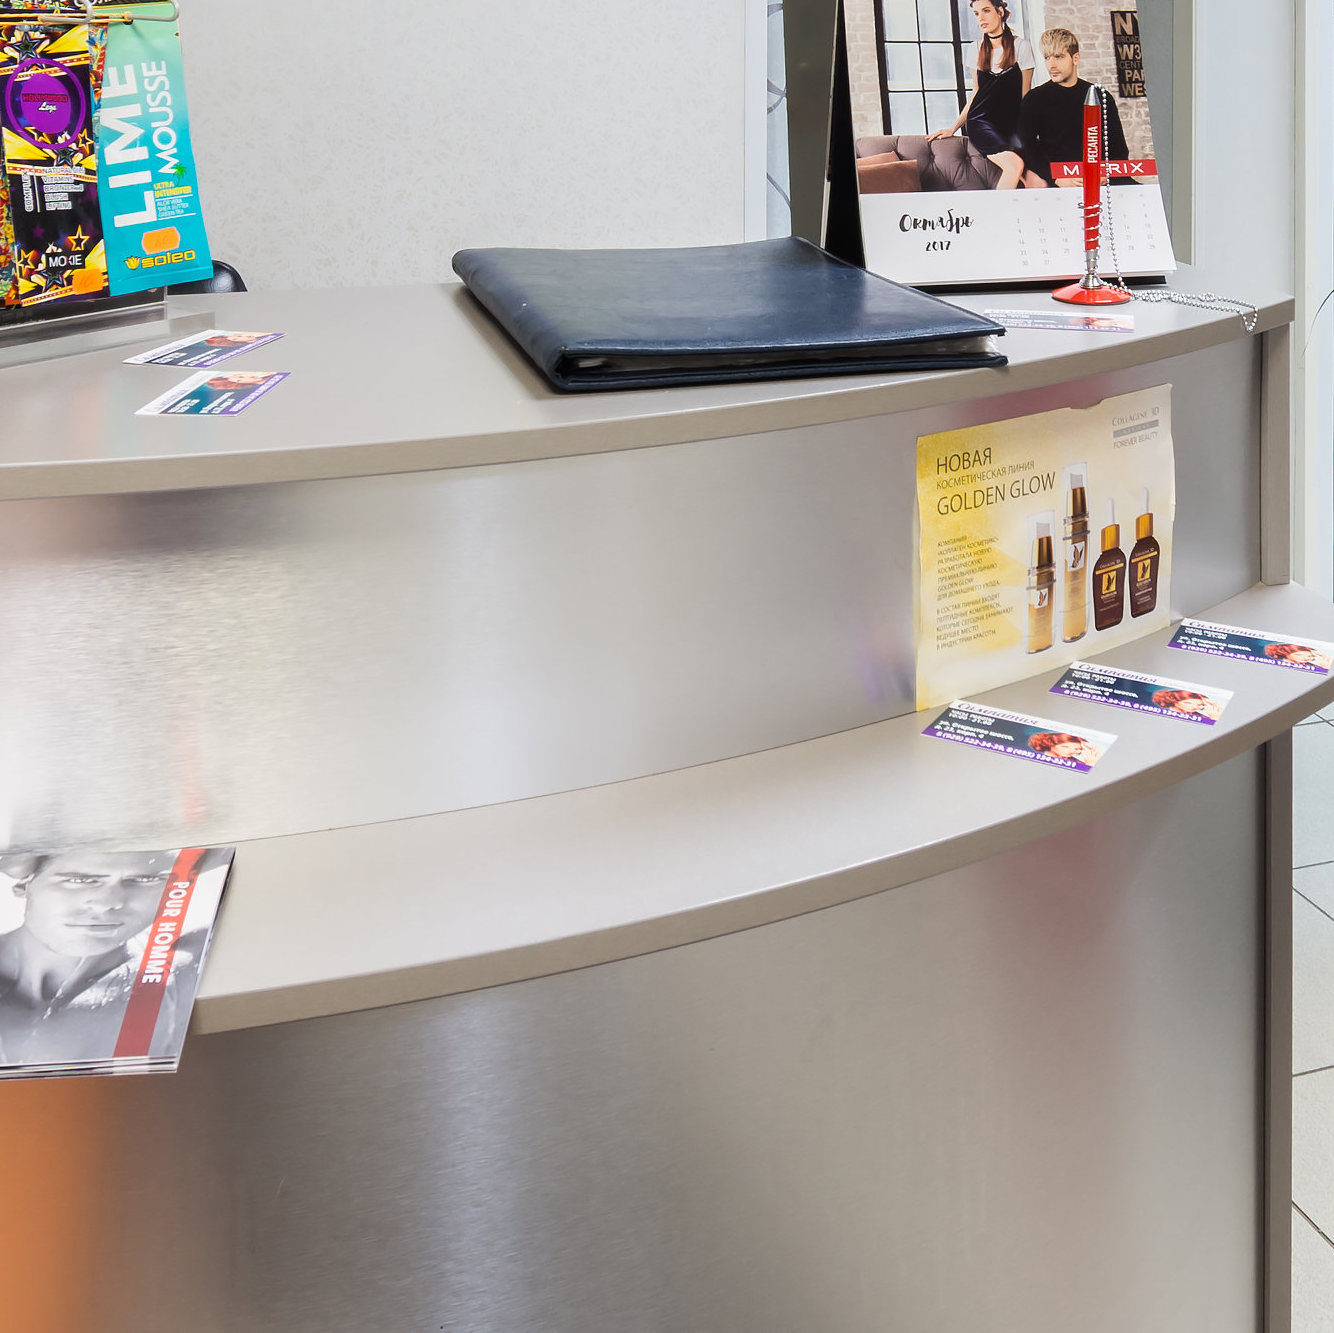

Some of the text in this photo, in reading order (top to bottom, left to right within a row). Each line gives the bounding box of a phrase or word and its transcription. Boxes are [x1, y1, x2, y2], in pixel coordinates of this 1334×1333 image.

[38, 101, 57, 113] Legs
[141, 60, 180, 174] MOUSSE
[100, 64, 157, 228] LIME
[1087, 126, 1099, 164] РЕСАНТА
[899, 209, 974, 234] Октябрь
[141, 249, 196, 269] soleo
[925, 240, 952, 252] 2017
[1112, 411, 1148, 426] COLLAGENE
[1113, 431, 1158, 449] FOREVER BEAUTY
[936, 447, 992, 475] НОВАЯ
[936, 460, 1035, 490] КОСМЕТИЧЕСКАЯ ЛИНИЯ
[937, 471, 1056, 516] GOLDEN GLOW
[957, 702, 1038, 726] Симпатия
[140, 879, 191, 986] POUR HOMME
